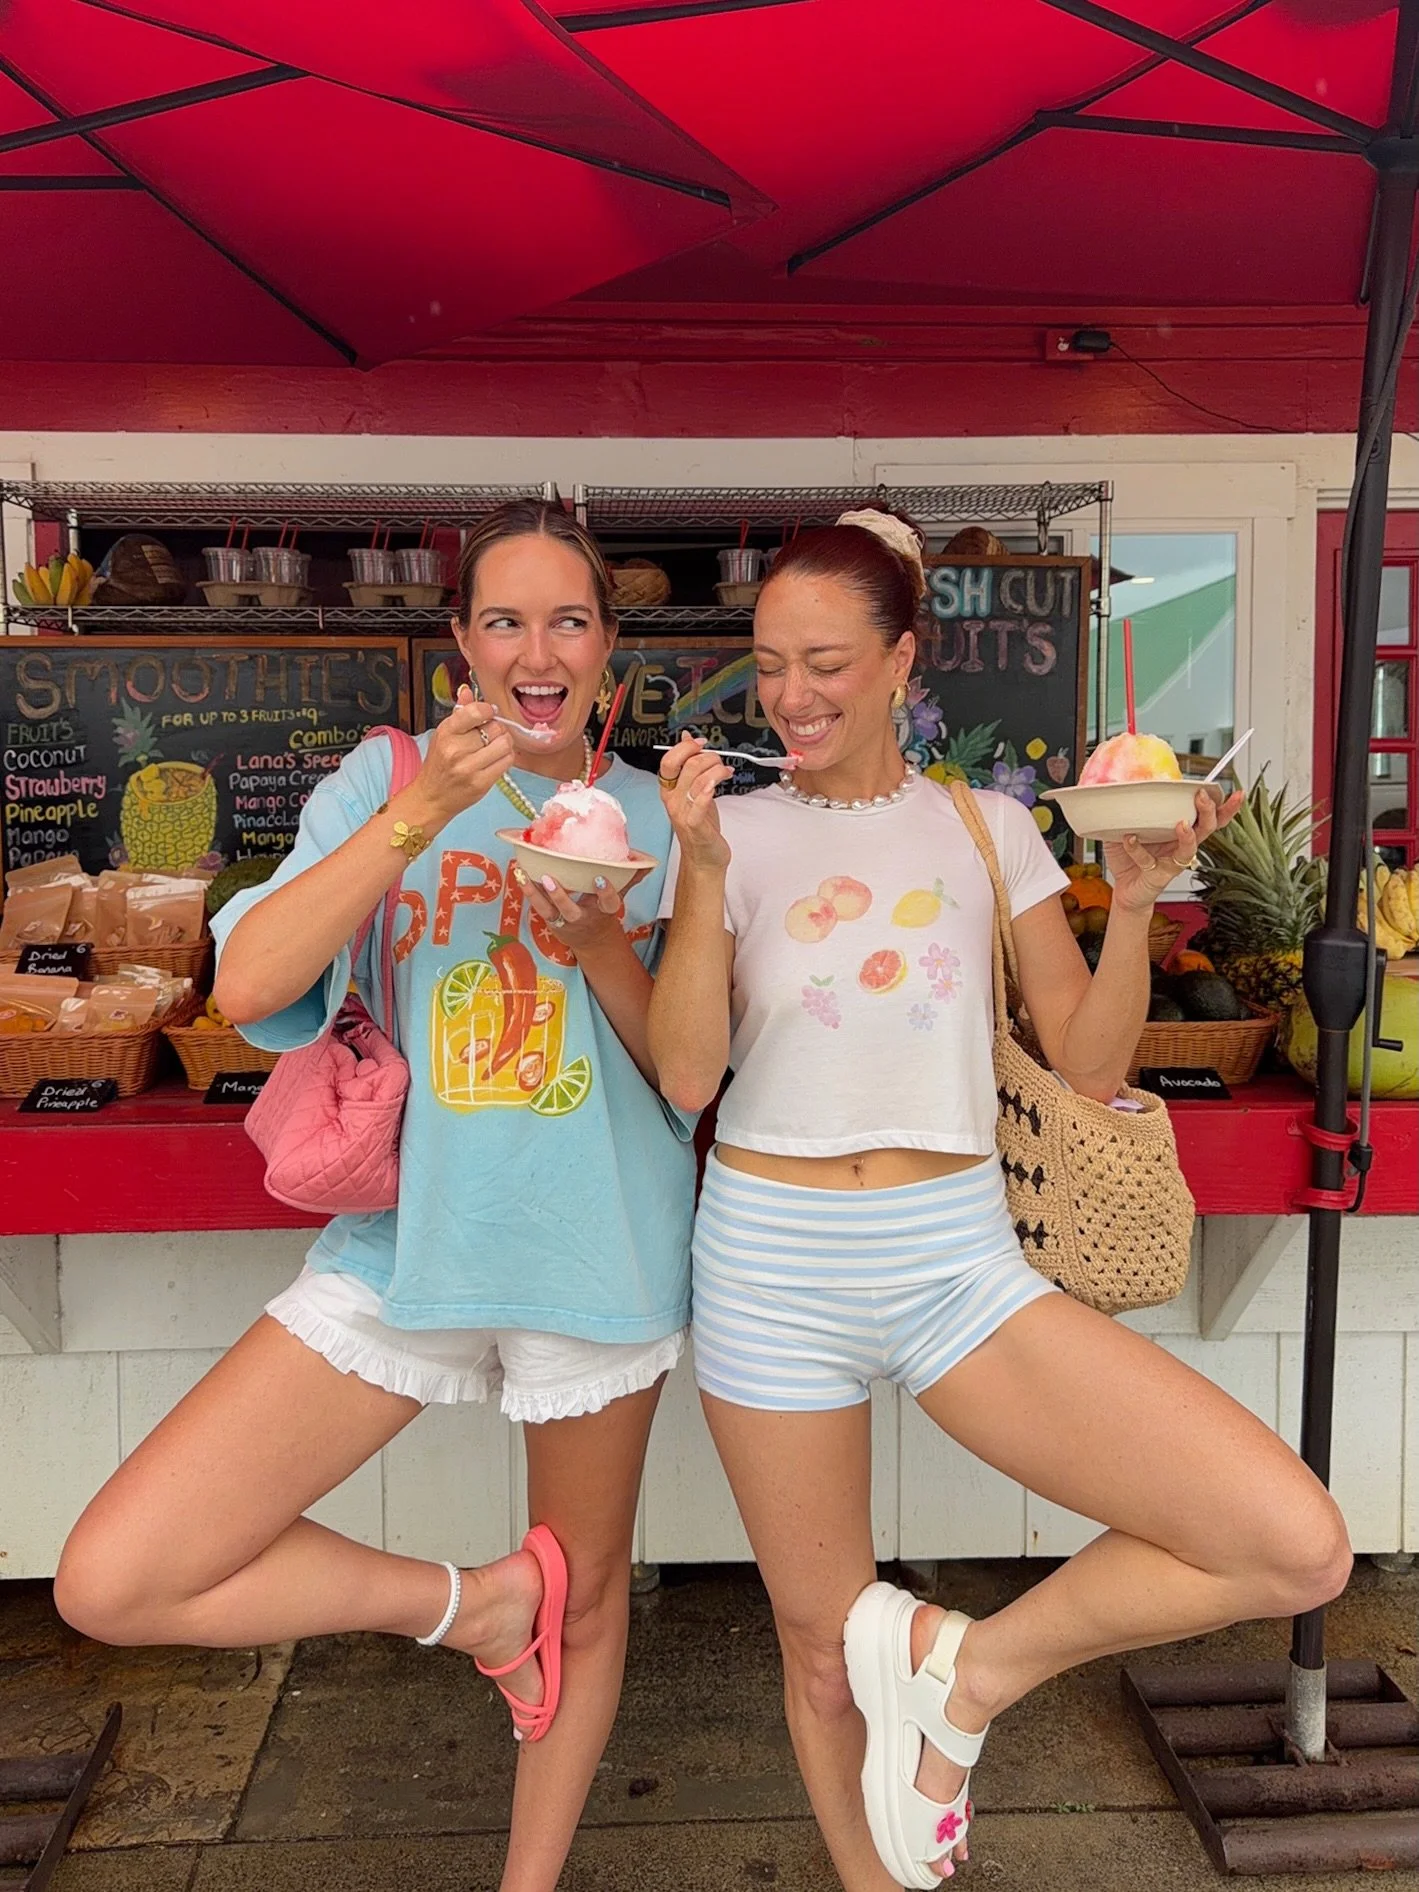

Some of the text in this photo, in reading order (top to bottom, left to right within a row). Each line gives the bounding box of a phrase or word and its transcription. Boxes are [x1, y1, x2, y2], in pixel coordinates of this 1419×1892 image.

[1001, 568, 1077, 618] CUT
[15, 651, 394, 720] SMOOTHIE'S
[161, 713, 194, 729] FOR
[200, 711, 218, 726] UP
[240, 709, 249, 723] 3
[7, 717, 75, 745] FRUIT'S
[228, 772, 287, 793] Papaya
[4, 799, 99, 827] Pineapple
[235, 794, 286, 815] Mango
[6, 827, 70, 849] Mango
[27, 947, 68, 962] Dried
[1159, 1075, 1222, 1089] Avocado
[36, 1096, 99, 1110] Pineapple
